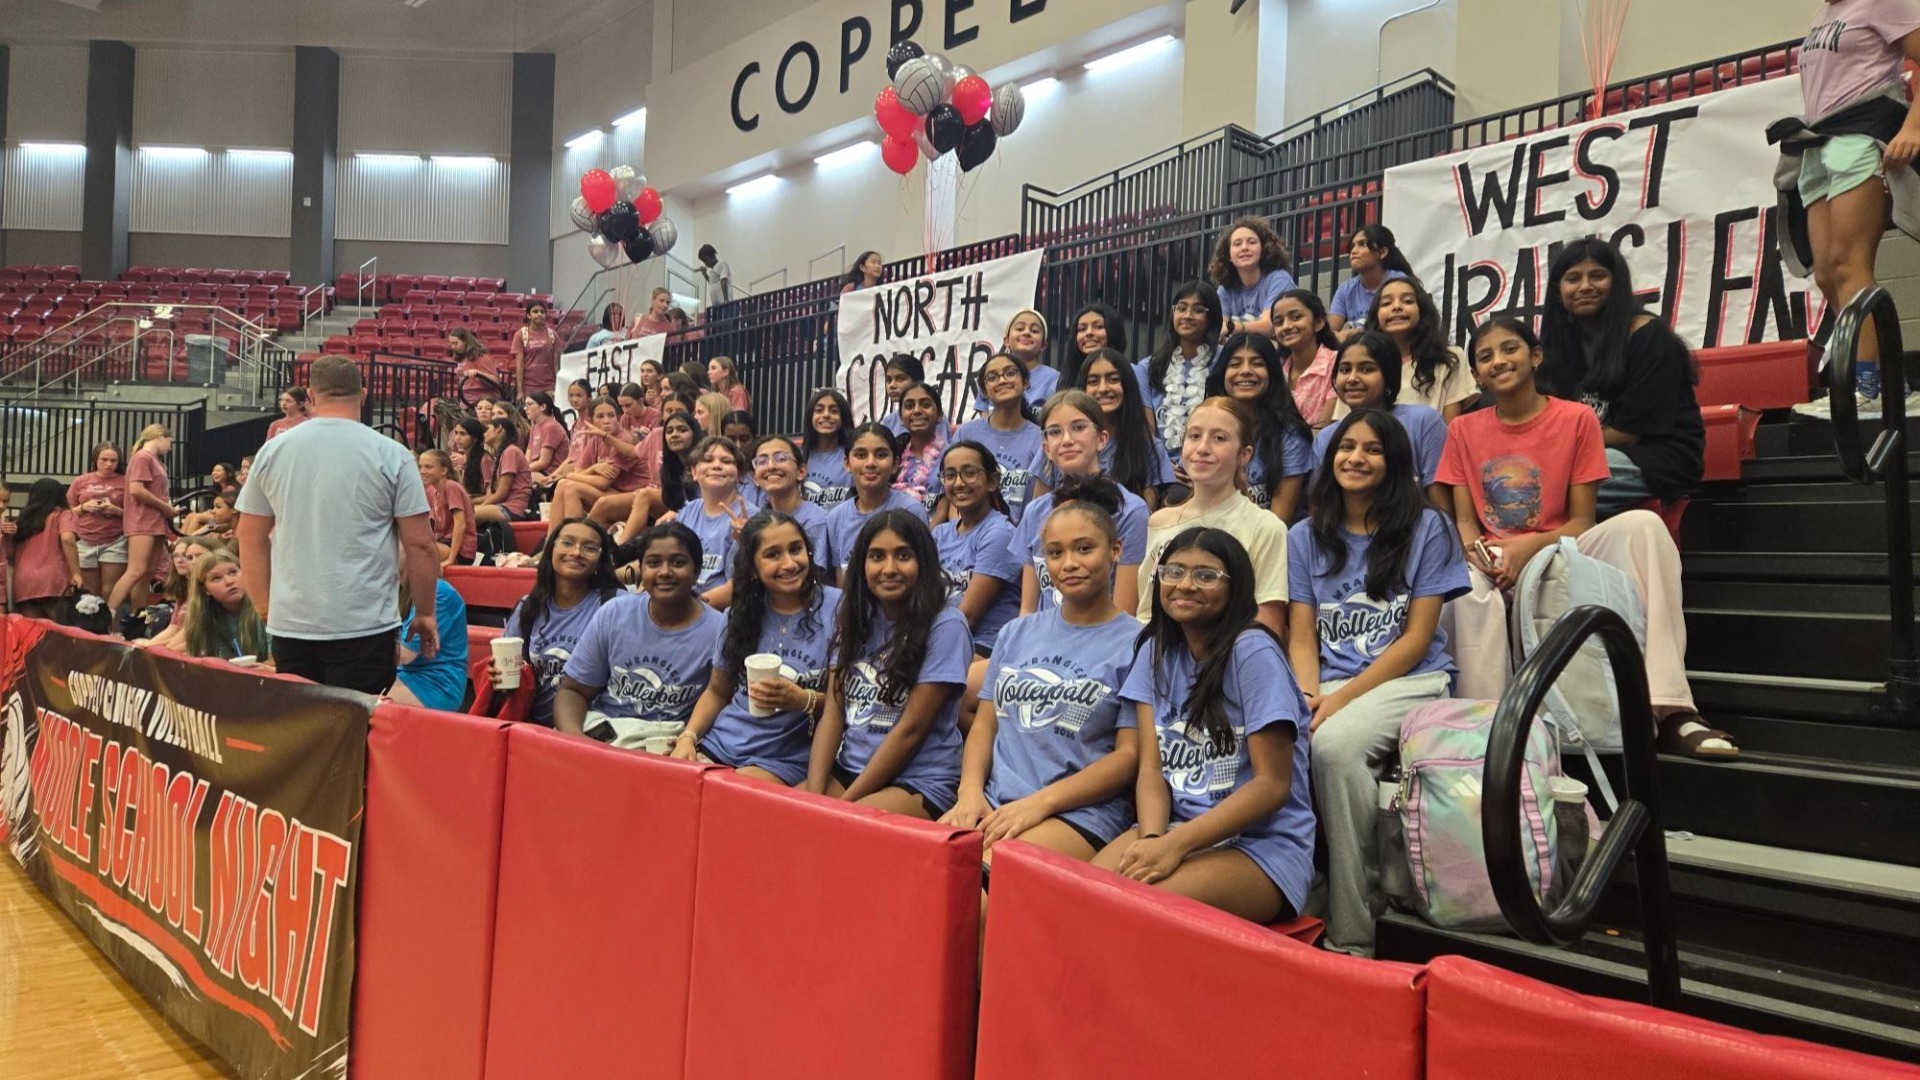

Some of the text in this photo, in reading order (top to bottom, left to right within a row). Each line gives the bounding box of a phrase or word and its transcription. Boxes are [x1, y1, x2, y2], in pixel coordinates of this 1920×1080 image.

[730, 0, 1047, 132] COPPE
[1452, 105, 1698, 237] WEST
[873, 272, 988, 344] NORTH
[586, 342, 639, 396] EAST
[1317, 604, 1408, 643] Volleyba
[611, 673, 697, 709] Volleyball
[996, 674, 1099, 714] Volleyball
[1054, 726, 1075, 740] 2026
[98, 740, 210, 944] SCHOOL
[204, 789, 352, 1037] NIGHT
